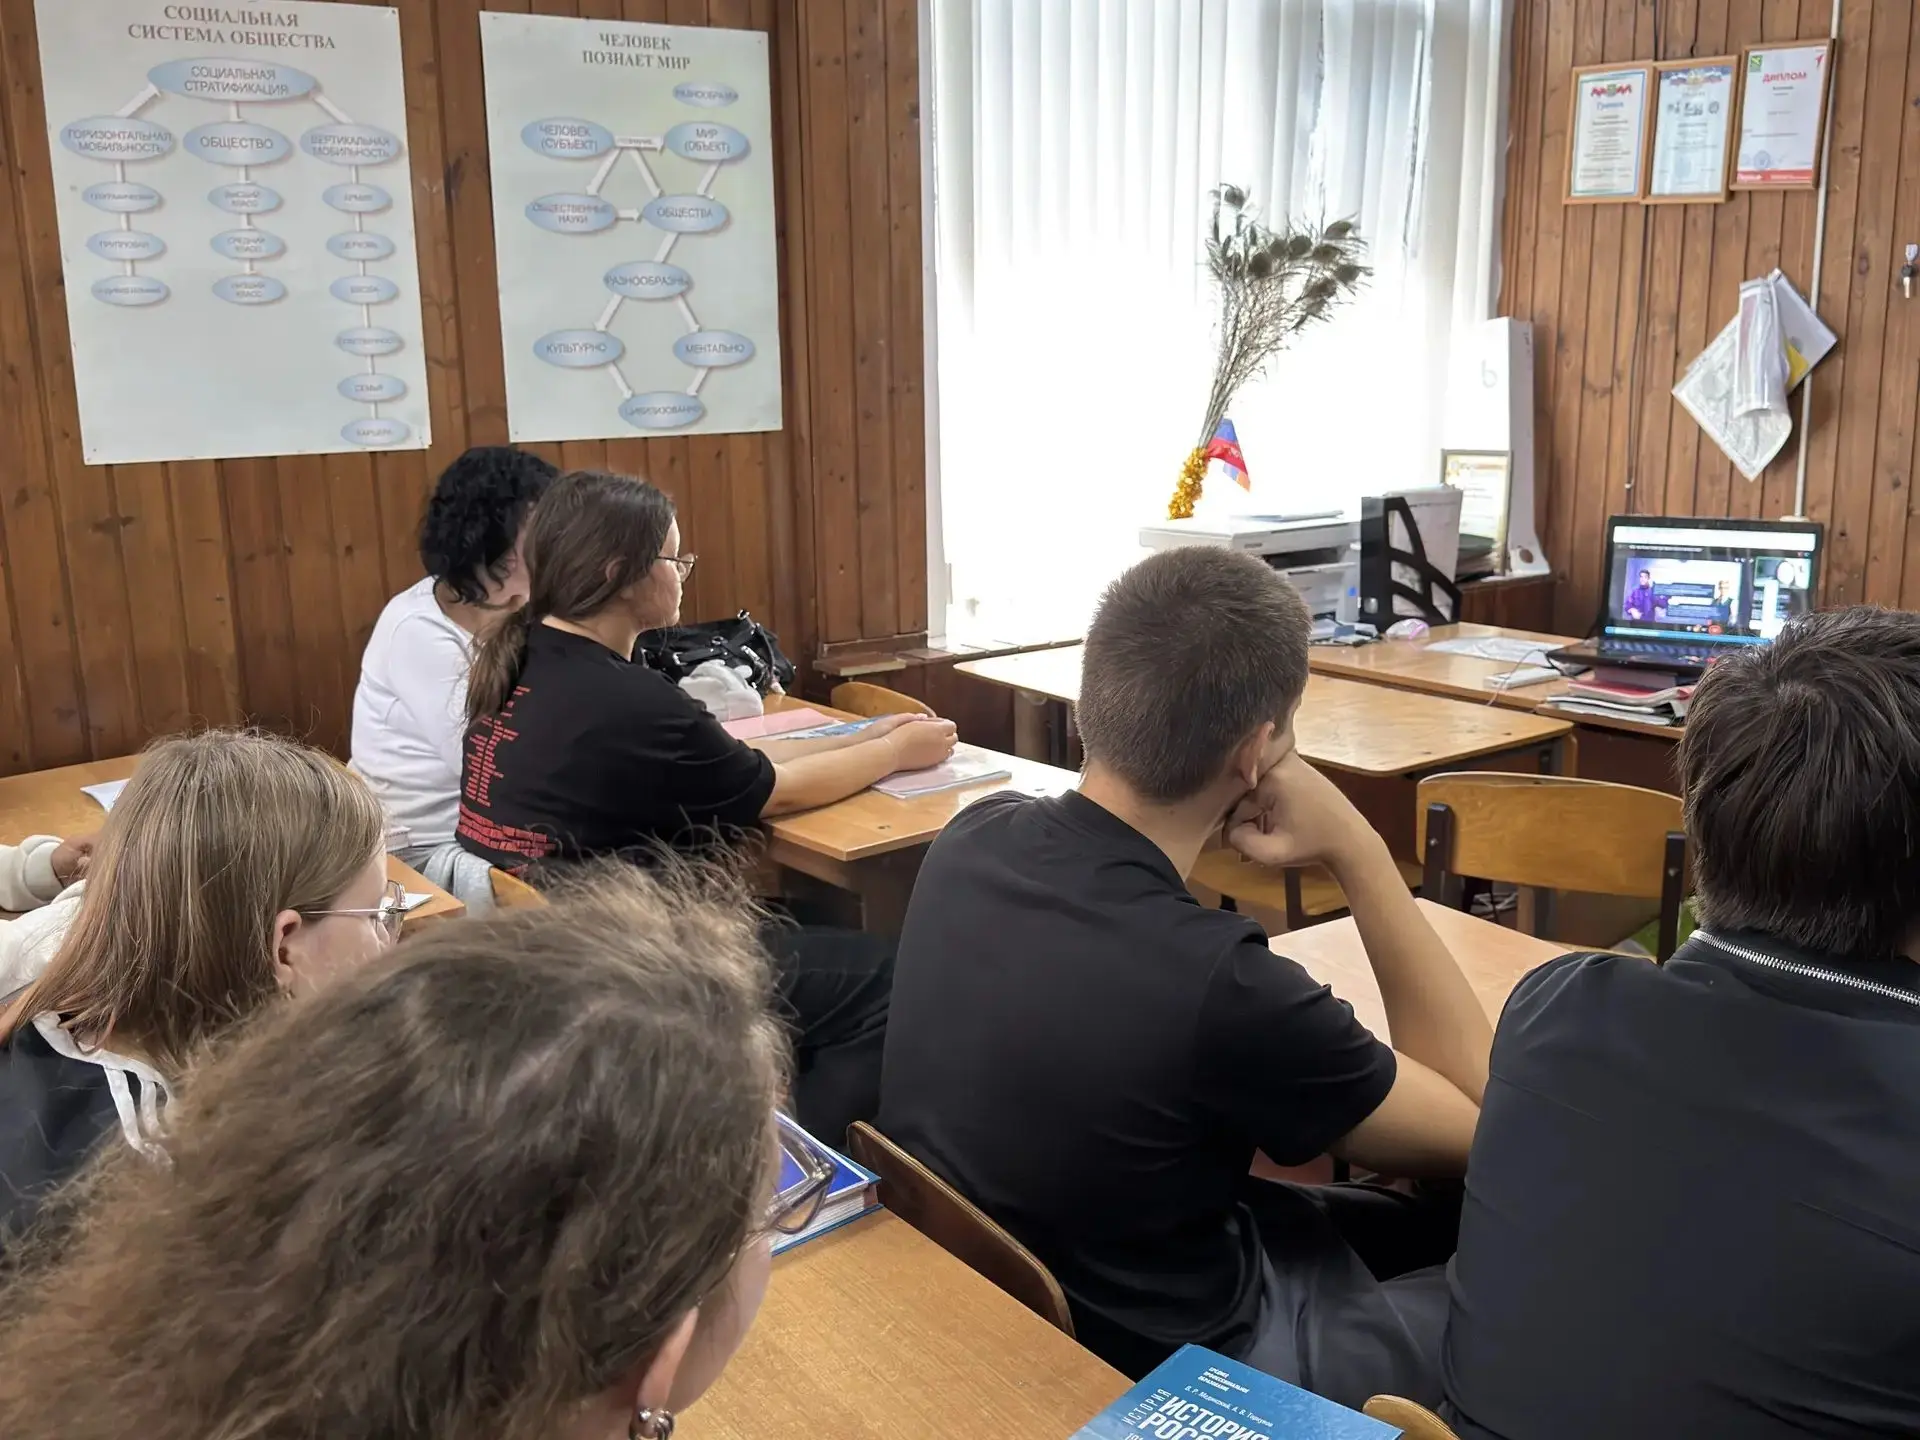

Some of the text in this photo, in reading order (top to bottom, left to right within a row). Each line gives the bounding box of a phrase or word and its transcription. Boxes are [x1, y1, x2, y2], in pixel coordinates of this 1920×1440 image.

[164, 5, 299, 27] СОЦИАЛЬНАЯ
[128, 25, 336, 49] СИСТЕМА ОБЩЕСТВА
[600, 33, 672, 50] ЧЕЛОВЕК
[582, 50, 691, 70] ПОЗНАЕТ МИР
[191, 66, 276, 80] СОЦИАЛЬНАЯ
[1762, 71, 1808, 83] ДИПЛОМ
[184, 80, 289, 95] СТРАТИФИКАЦИЯ
[67, 129, 172, 142] ГОРИЗОНТАЛЬНАЯ
[539, 125, 592, 137] ЧЕЛОВЕК
[695, 127, 718, 139] МИР
[78, 141, 164, 153] МОБИЛЬНОСТЬ
[200, 136, 273, 150] ОБЩЕСТВО
[541, 136, 598, 150] (СУБЪЕКТ)
[684, 140, 731, 153] (ОБЪЕКТ)
[557, 214, 588, 224] НАУКИ
[656, 206, 714, 219] ОБЩЕСТВА
[546, 342, 608, 354] КУЛЬТУРНО
[685, 343, 745, 354] МЕНТАЛЬНО
[1121, 1388, 1172, 1426] ИСТОРИЯ
